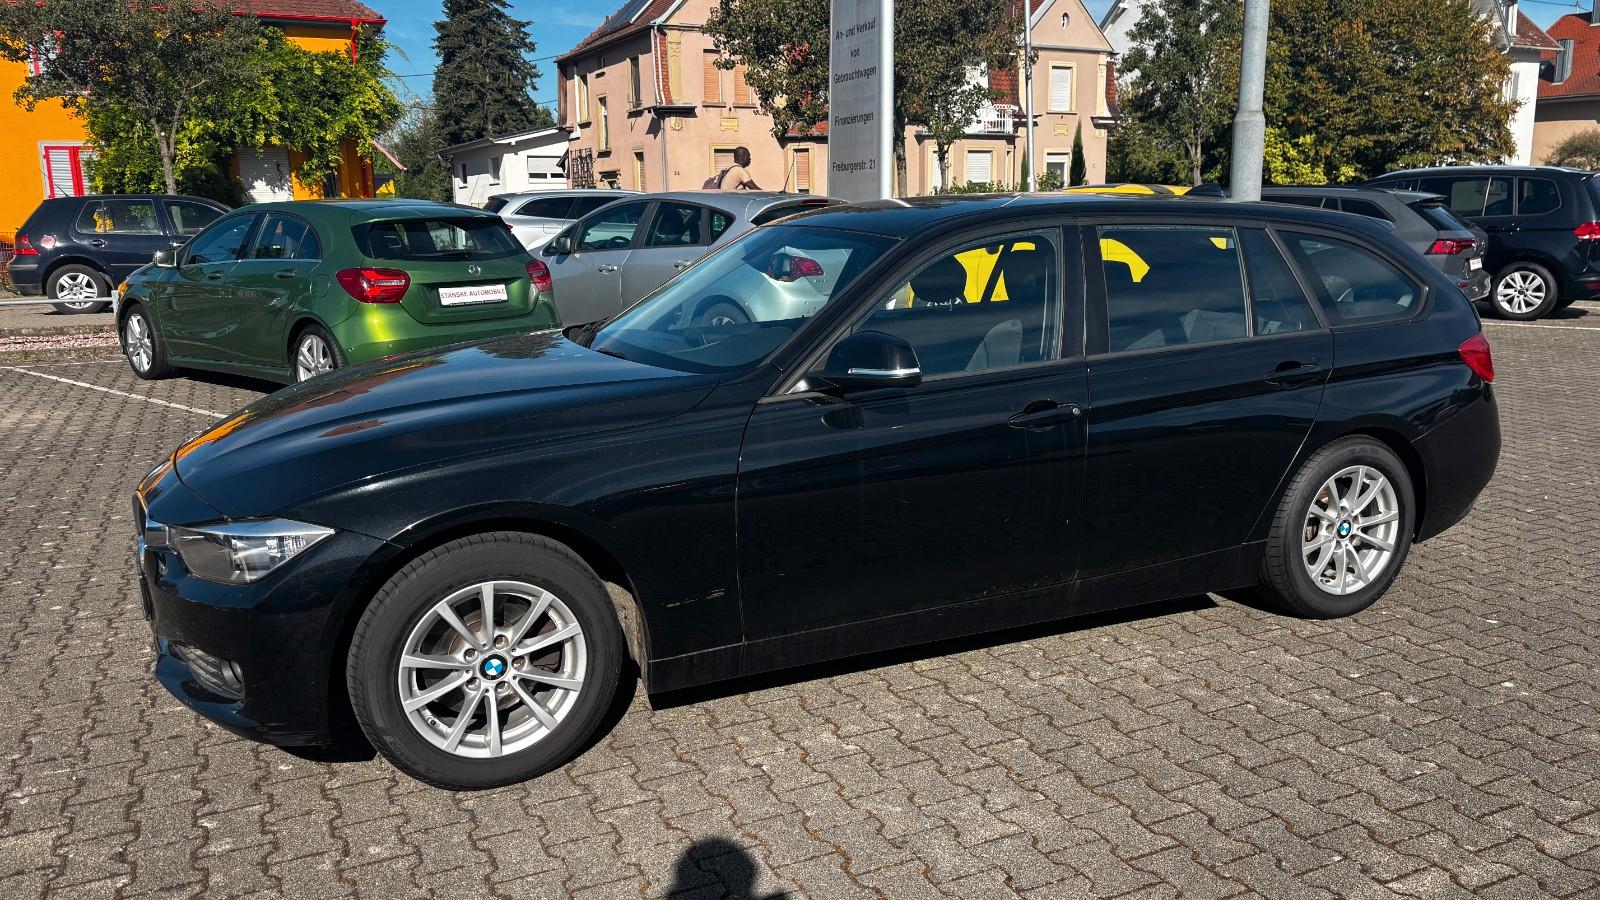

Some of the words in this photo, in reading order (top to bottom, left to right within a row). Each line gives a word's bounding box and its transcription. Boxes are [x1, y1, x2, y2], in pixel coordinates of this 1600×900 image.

[836, 30, 845, 40] An-
[846, 24, 855, 37] und
[856, 18, 876, 33] Verkauf
[850, 48, 860, 58] von
[833, 66, 877, 84] Gebrauchtwagen
[834, 112, 874, 127] Finanzierungen
[832, 160, 867, 174] Freiburgerstr.
[868, 159, 876, 170] 21
